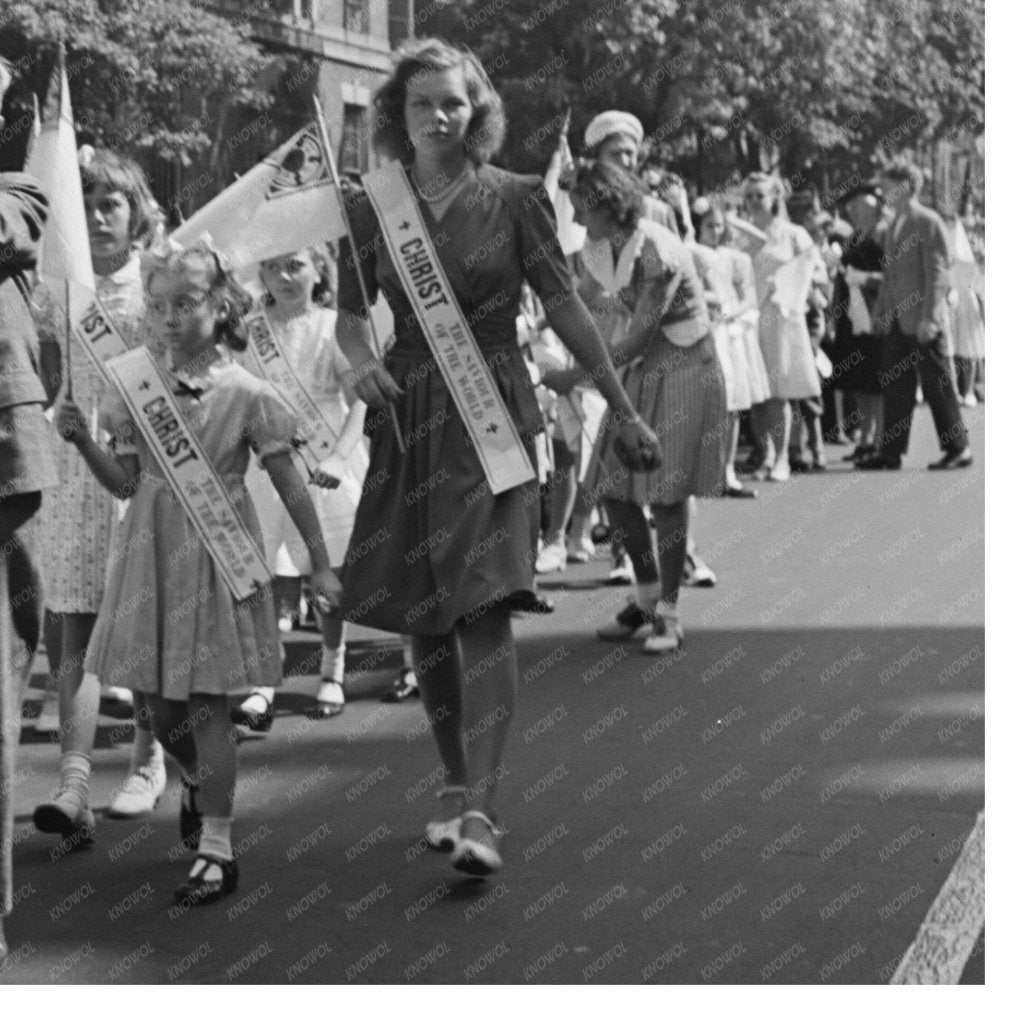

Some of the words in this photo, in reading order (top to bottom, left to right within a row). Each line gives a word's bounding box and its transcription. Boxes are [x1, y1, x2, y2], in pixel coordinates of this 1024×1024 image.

[399, 237, 449, 310] CHRIST
[449, 322, 469, 347] THE
[433, 323, 449, 340] OF
[444, 345, 462, 373] THE
[458, 375, 485, 421] WORLD
[142, 395, 199, 468] CHRIST
